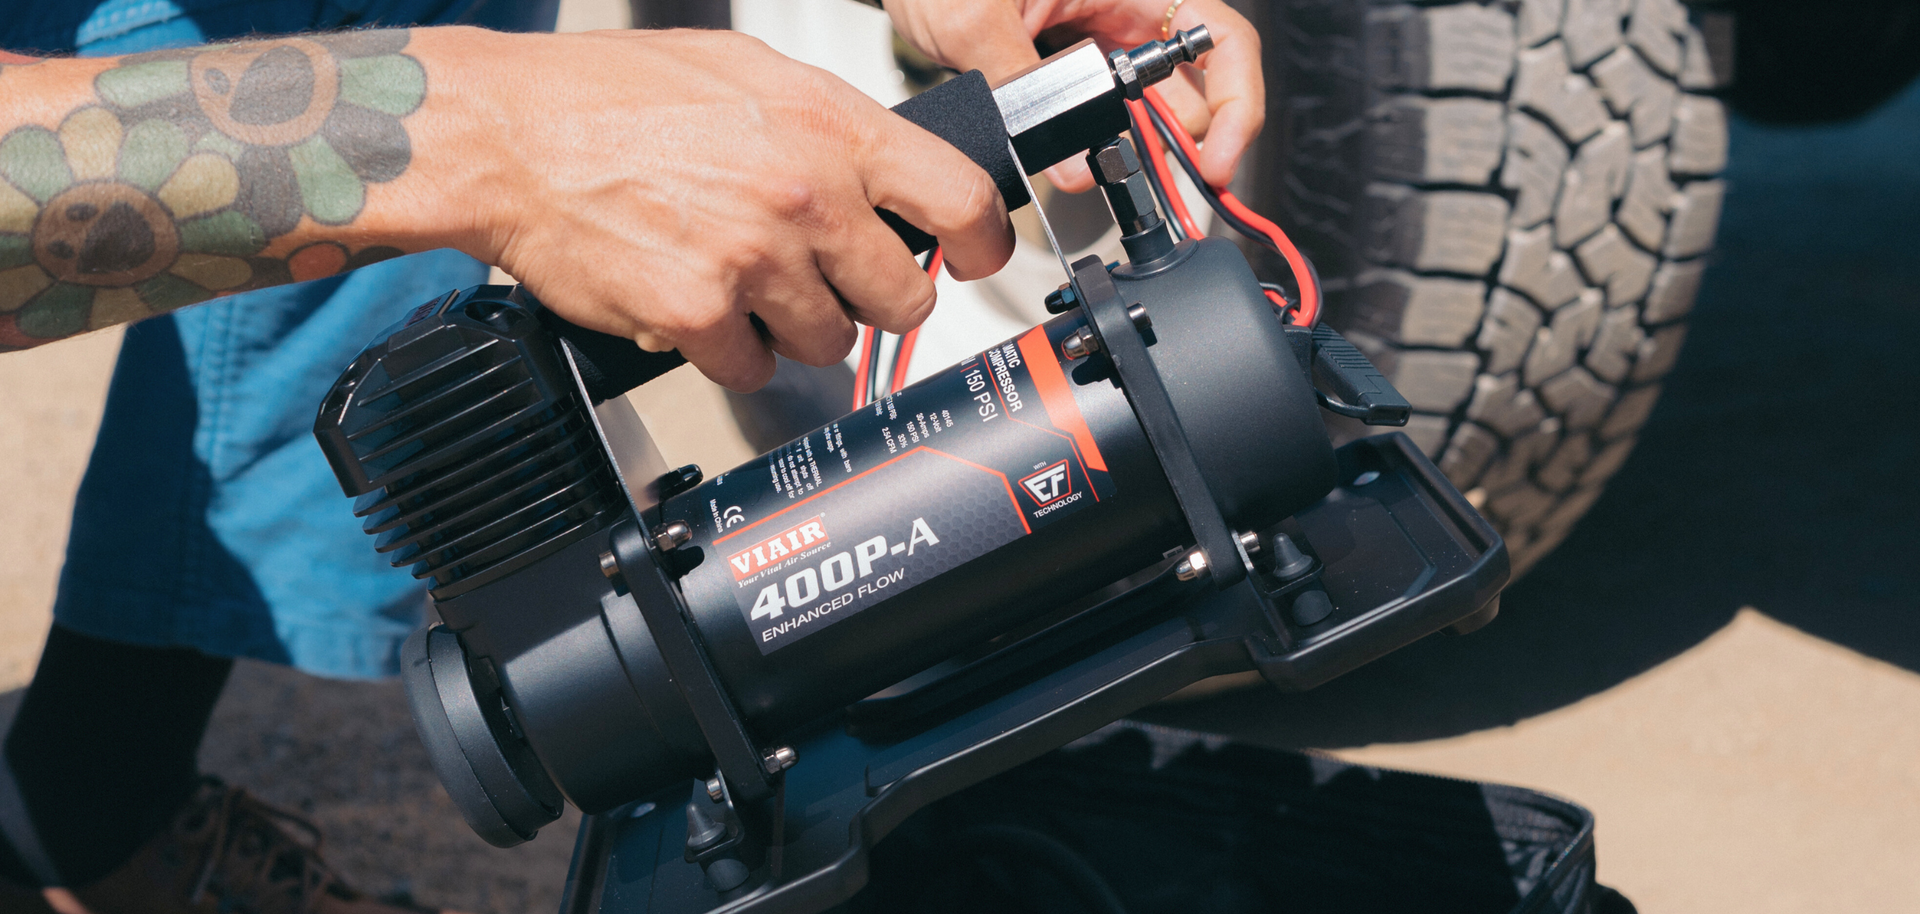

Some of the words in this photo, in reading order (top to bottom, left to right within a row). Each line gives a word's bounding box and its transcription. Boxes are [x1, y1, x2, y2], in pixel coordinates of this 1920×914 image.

[1002, 342, 1021, 368] MATIC
[965, 369, 986, 392] 150
[988, 348, 1023, 413] COMPRESSOR
[973, 391, 998, 422] PSI
[906, 421, 916, 433] 150
[916, 412, 930, 439] 30-Amps
[929, 412, 942, 433] 12-Volt
[942, 409, 954, 428] 40145
[881, 427, 892, 440] 2.54
[897, 433, 908, 449] 33%
[910, 431, 920, 443] PSI
[886, 438, 897, 454] CFM
[809, 460, 822, 487] THERMAL
[843, 459, 852, 473] bare
[1032, 461, 1047, 470] WITH
[782, 472, 791, 484] cool
[785, 483, 794, 491] off
[791, 469, 802, 488] attempt
[797, 487, 804, 495] to
[806, 482, 814, 491] off
[1033, 490, 1083, 519] TECHNOLOGY
[714, 516, 723, 533] China
[730, 520, 826, 575] VIAIR
[737, 575, 759, 589] Your
[760, 564, 782, 579] Vital
[783, 556, 798, 570] Air
[799, 541, 832, 561] Source
[750, 516, 940, 621] 400P-A
[761, 592, 854, 643] ENHANCED
[857, 567, 906, 599] FLOW
